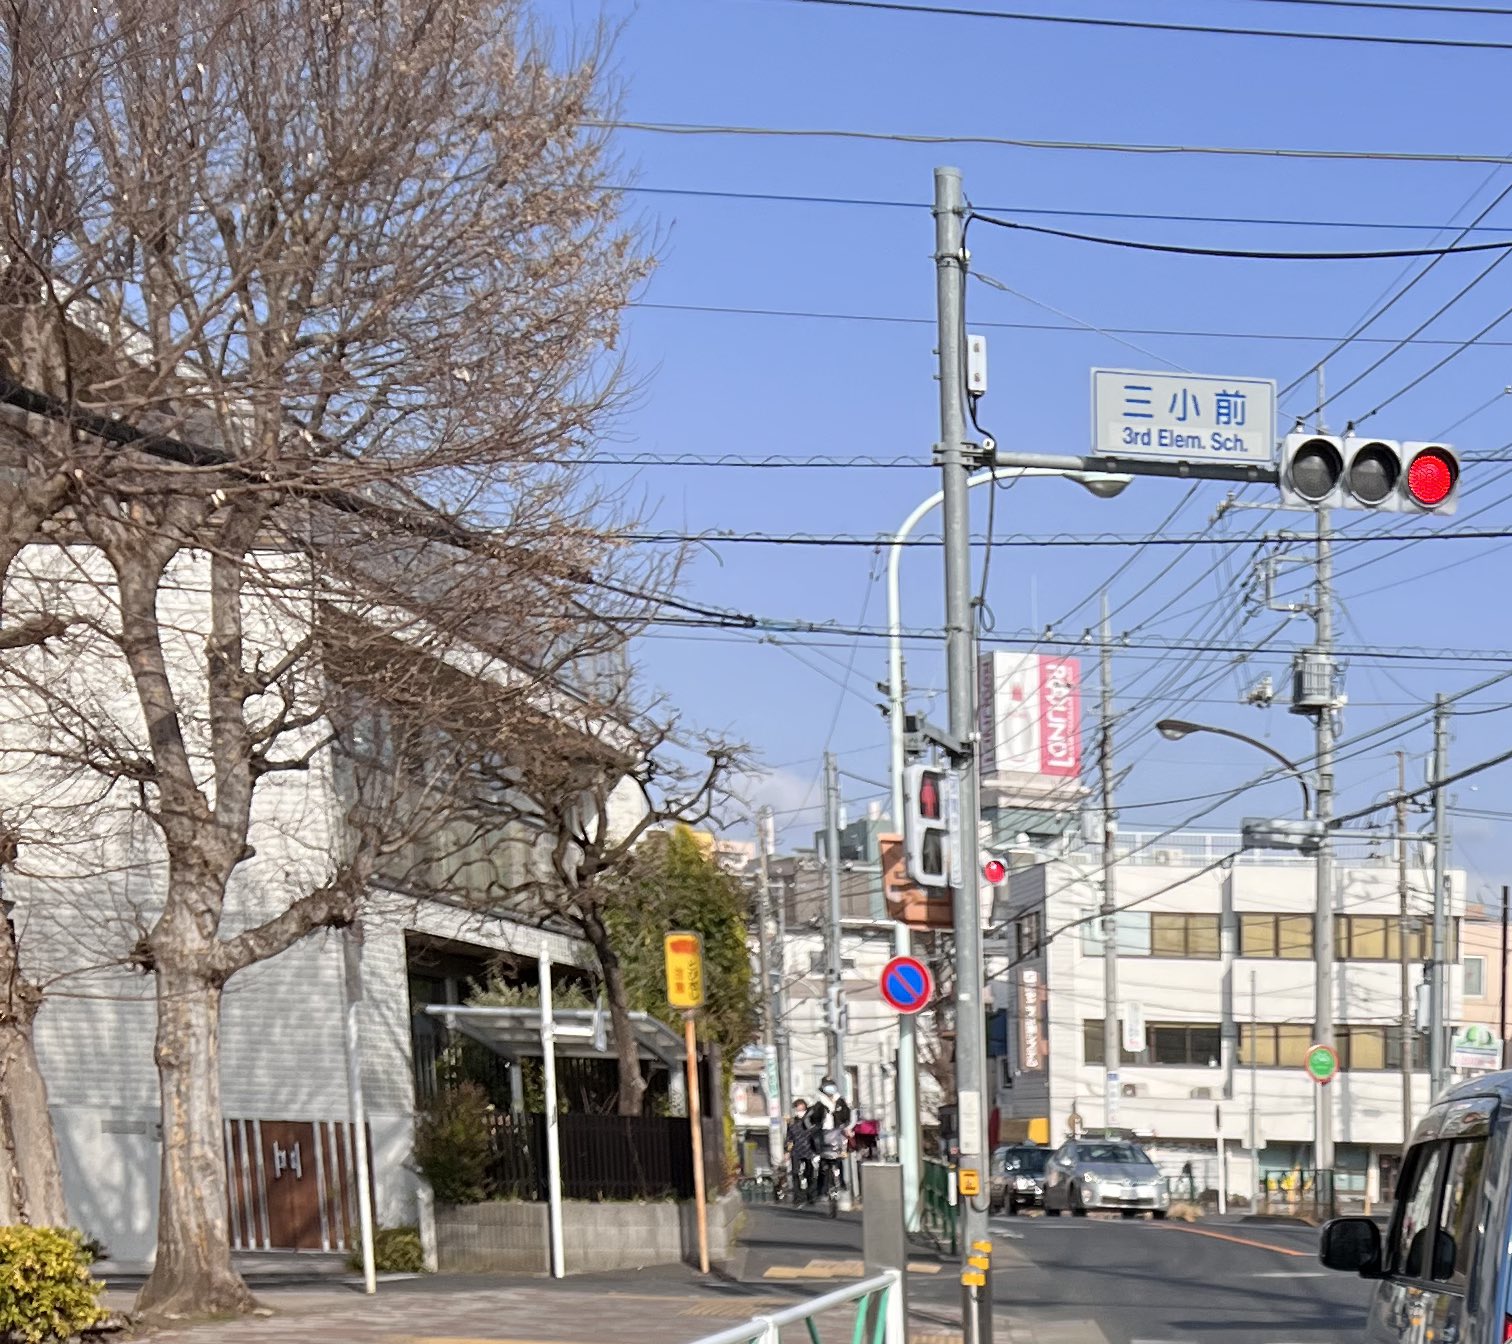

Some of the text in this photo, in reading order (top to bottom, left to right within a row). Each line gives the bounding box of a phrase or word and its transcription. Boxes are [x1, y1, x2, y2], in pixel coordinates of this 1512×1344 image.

[1122, 385, 1247, 426] 三小前
[1122, 426, 1248, 451] 3rd Elem. Sch.
